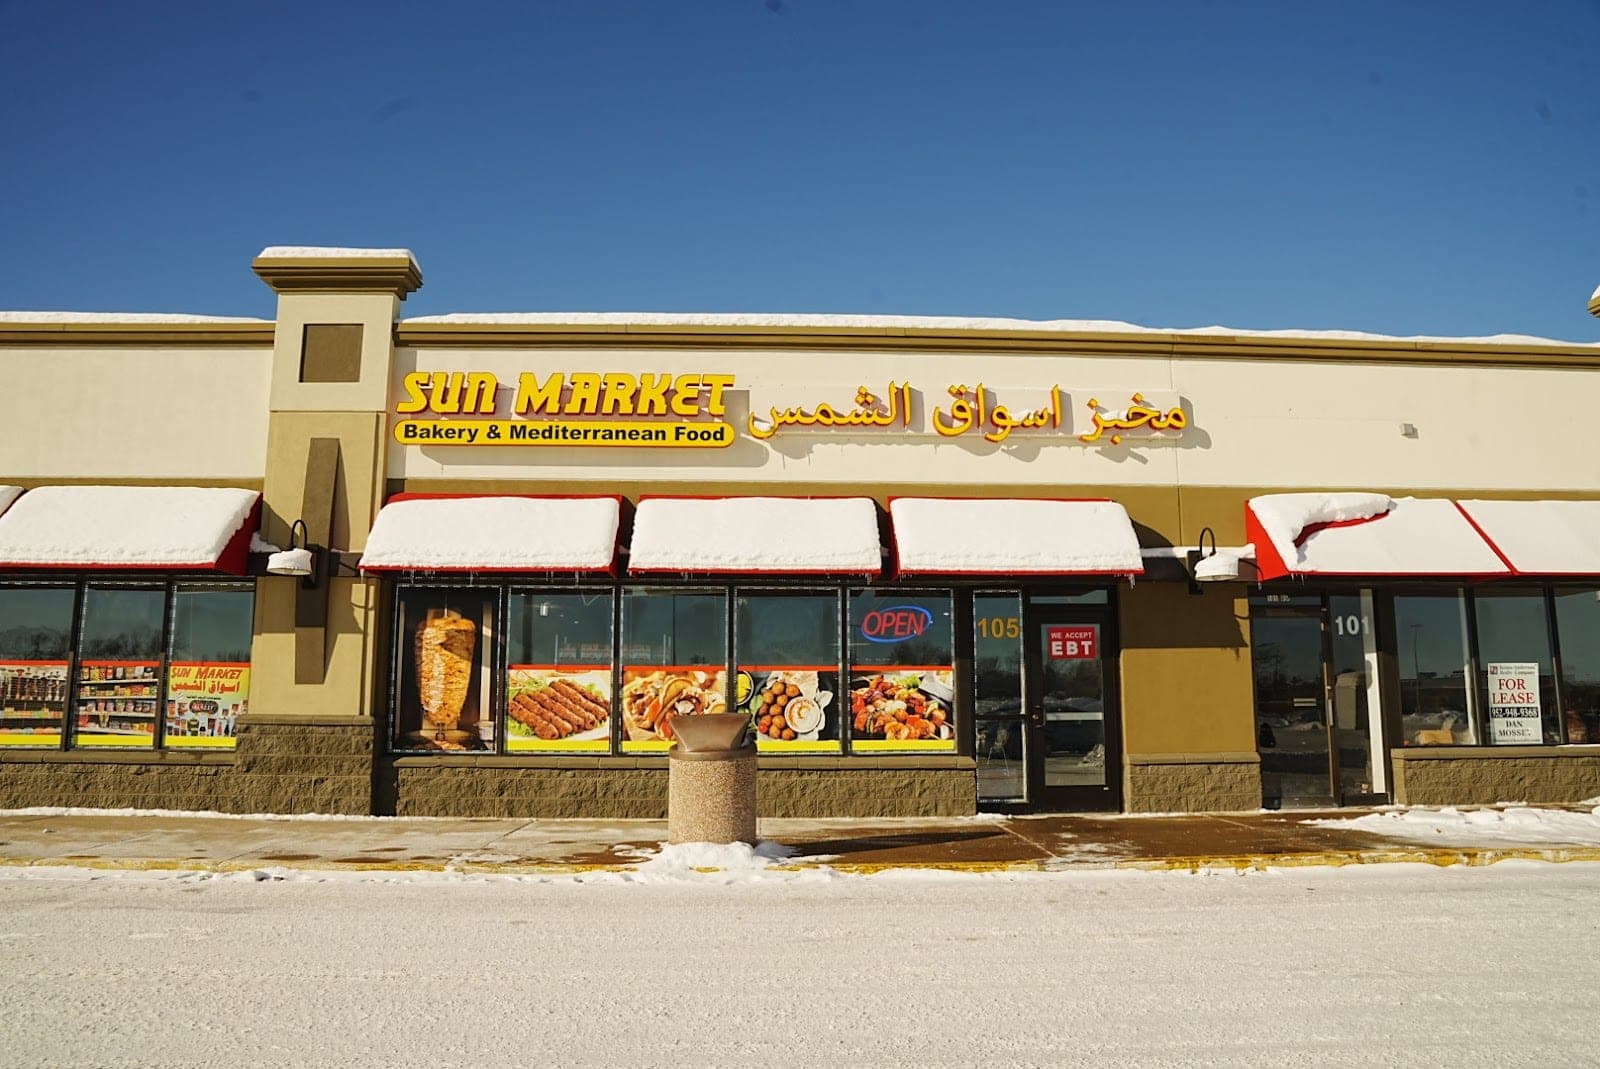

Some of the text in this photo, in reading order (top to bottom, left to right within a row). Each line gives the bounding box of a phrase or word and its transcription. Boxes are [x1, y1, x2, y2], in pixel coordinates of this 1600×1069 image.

[397, 371, 735, 416] SUN MARKET
[748, 380, 1188, 445] مخبز اسواق الشمس
[404, 424, 725, 442] Bakery & Mediterranean Food
[863, 611, 925, 637] OPEN
[978, 617, 1021, 640] 105
[1335, 614, 1370, 636] 101
[1065, 631, 1092, 639] ACCEPT
[1051, 640, 1092, 656] EBT
[170, 667, 242, 680] SUN MARKET
[1498, 678, 1526, 690] FOR
[1492, 692, 1536, 705] LEASE
[1506, 720, 1523, 728] DAN
